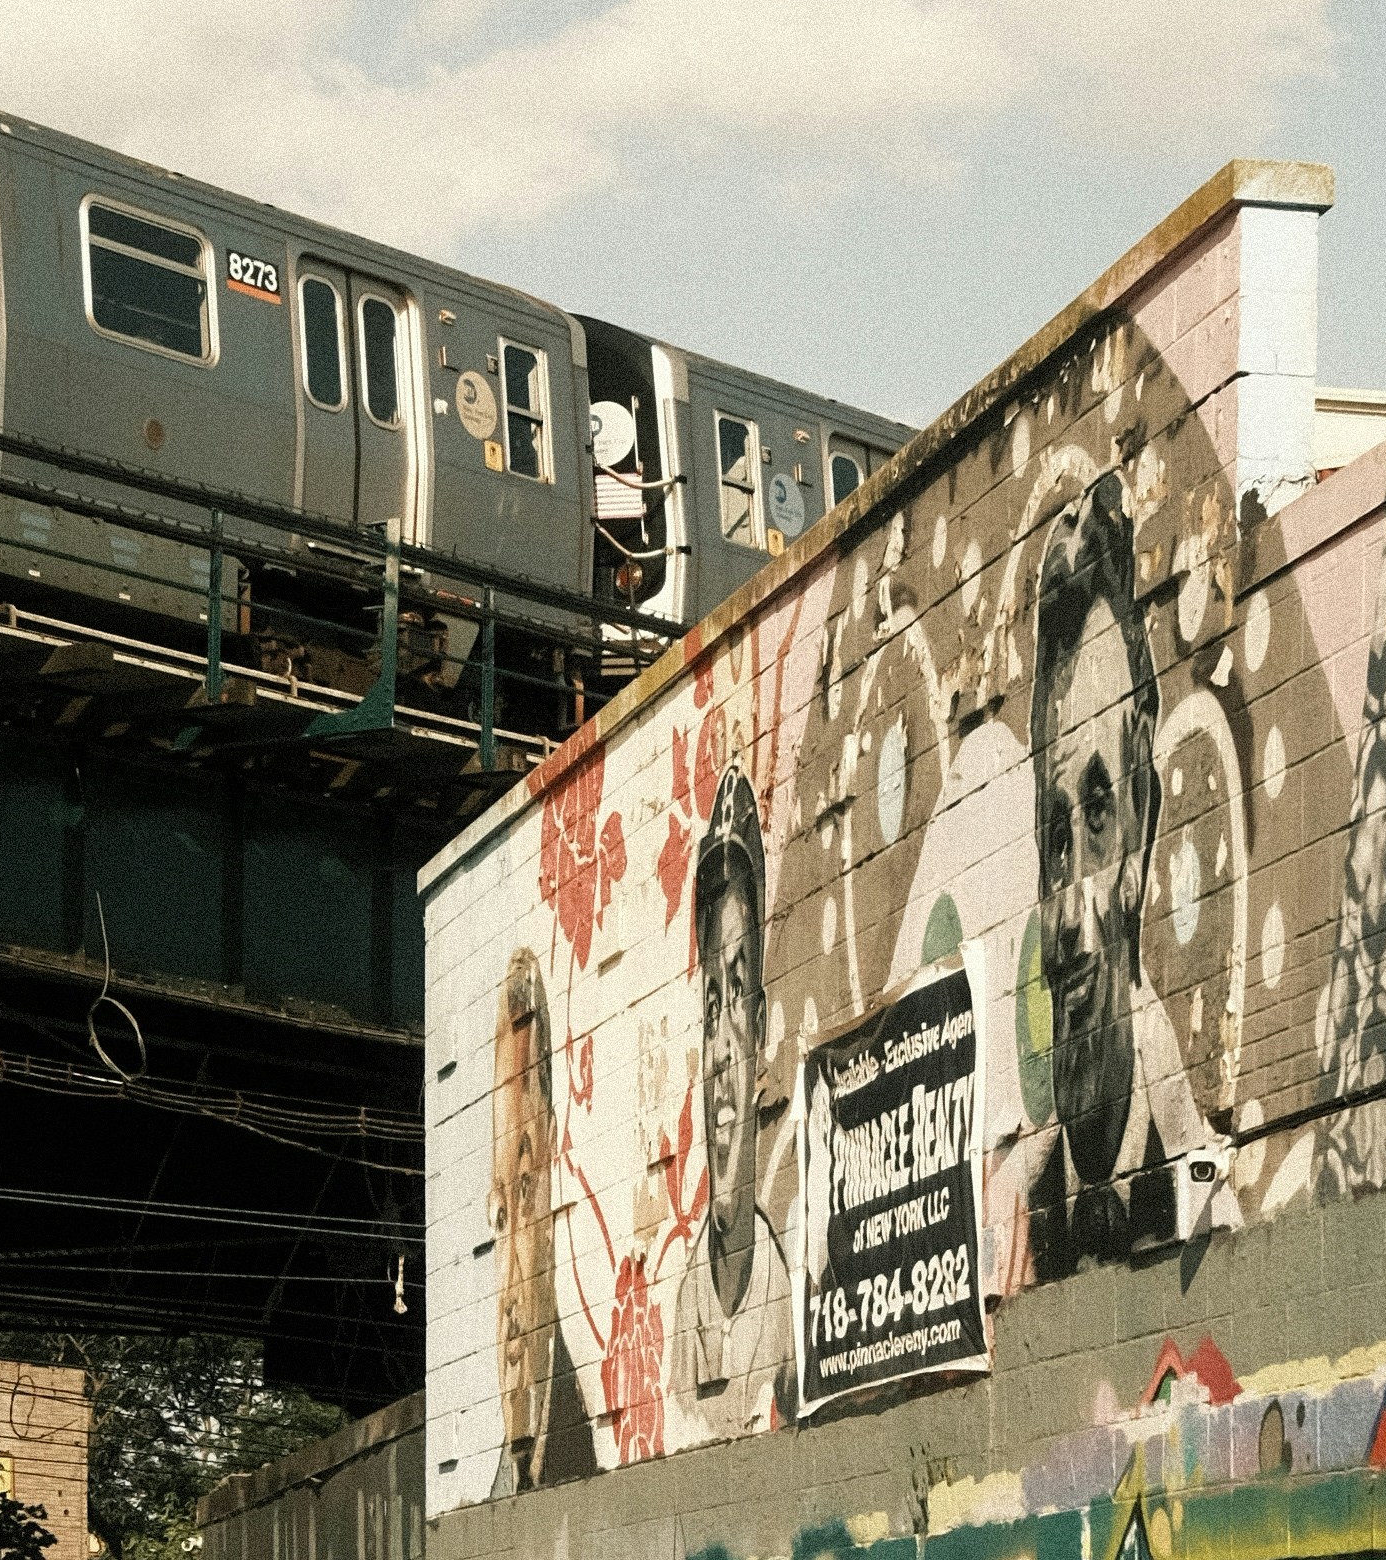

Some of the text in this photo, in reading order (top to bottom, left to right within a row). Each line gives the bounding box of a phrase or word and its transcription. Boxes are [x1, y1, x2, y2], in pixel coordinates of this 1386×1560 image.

[229, 253, 278, 292] 8273
[833, 1103, 912, 1216] PINNACLE
[853, 1186, 950, 1254] of NEW YORK LLC
[809, 1243, 971, 1347] 718-784-8282
[819, 1318, 961, 1378] www.pinnaclereny.com
